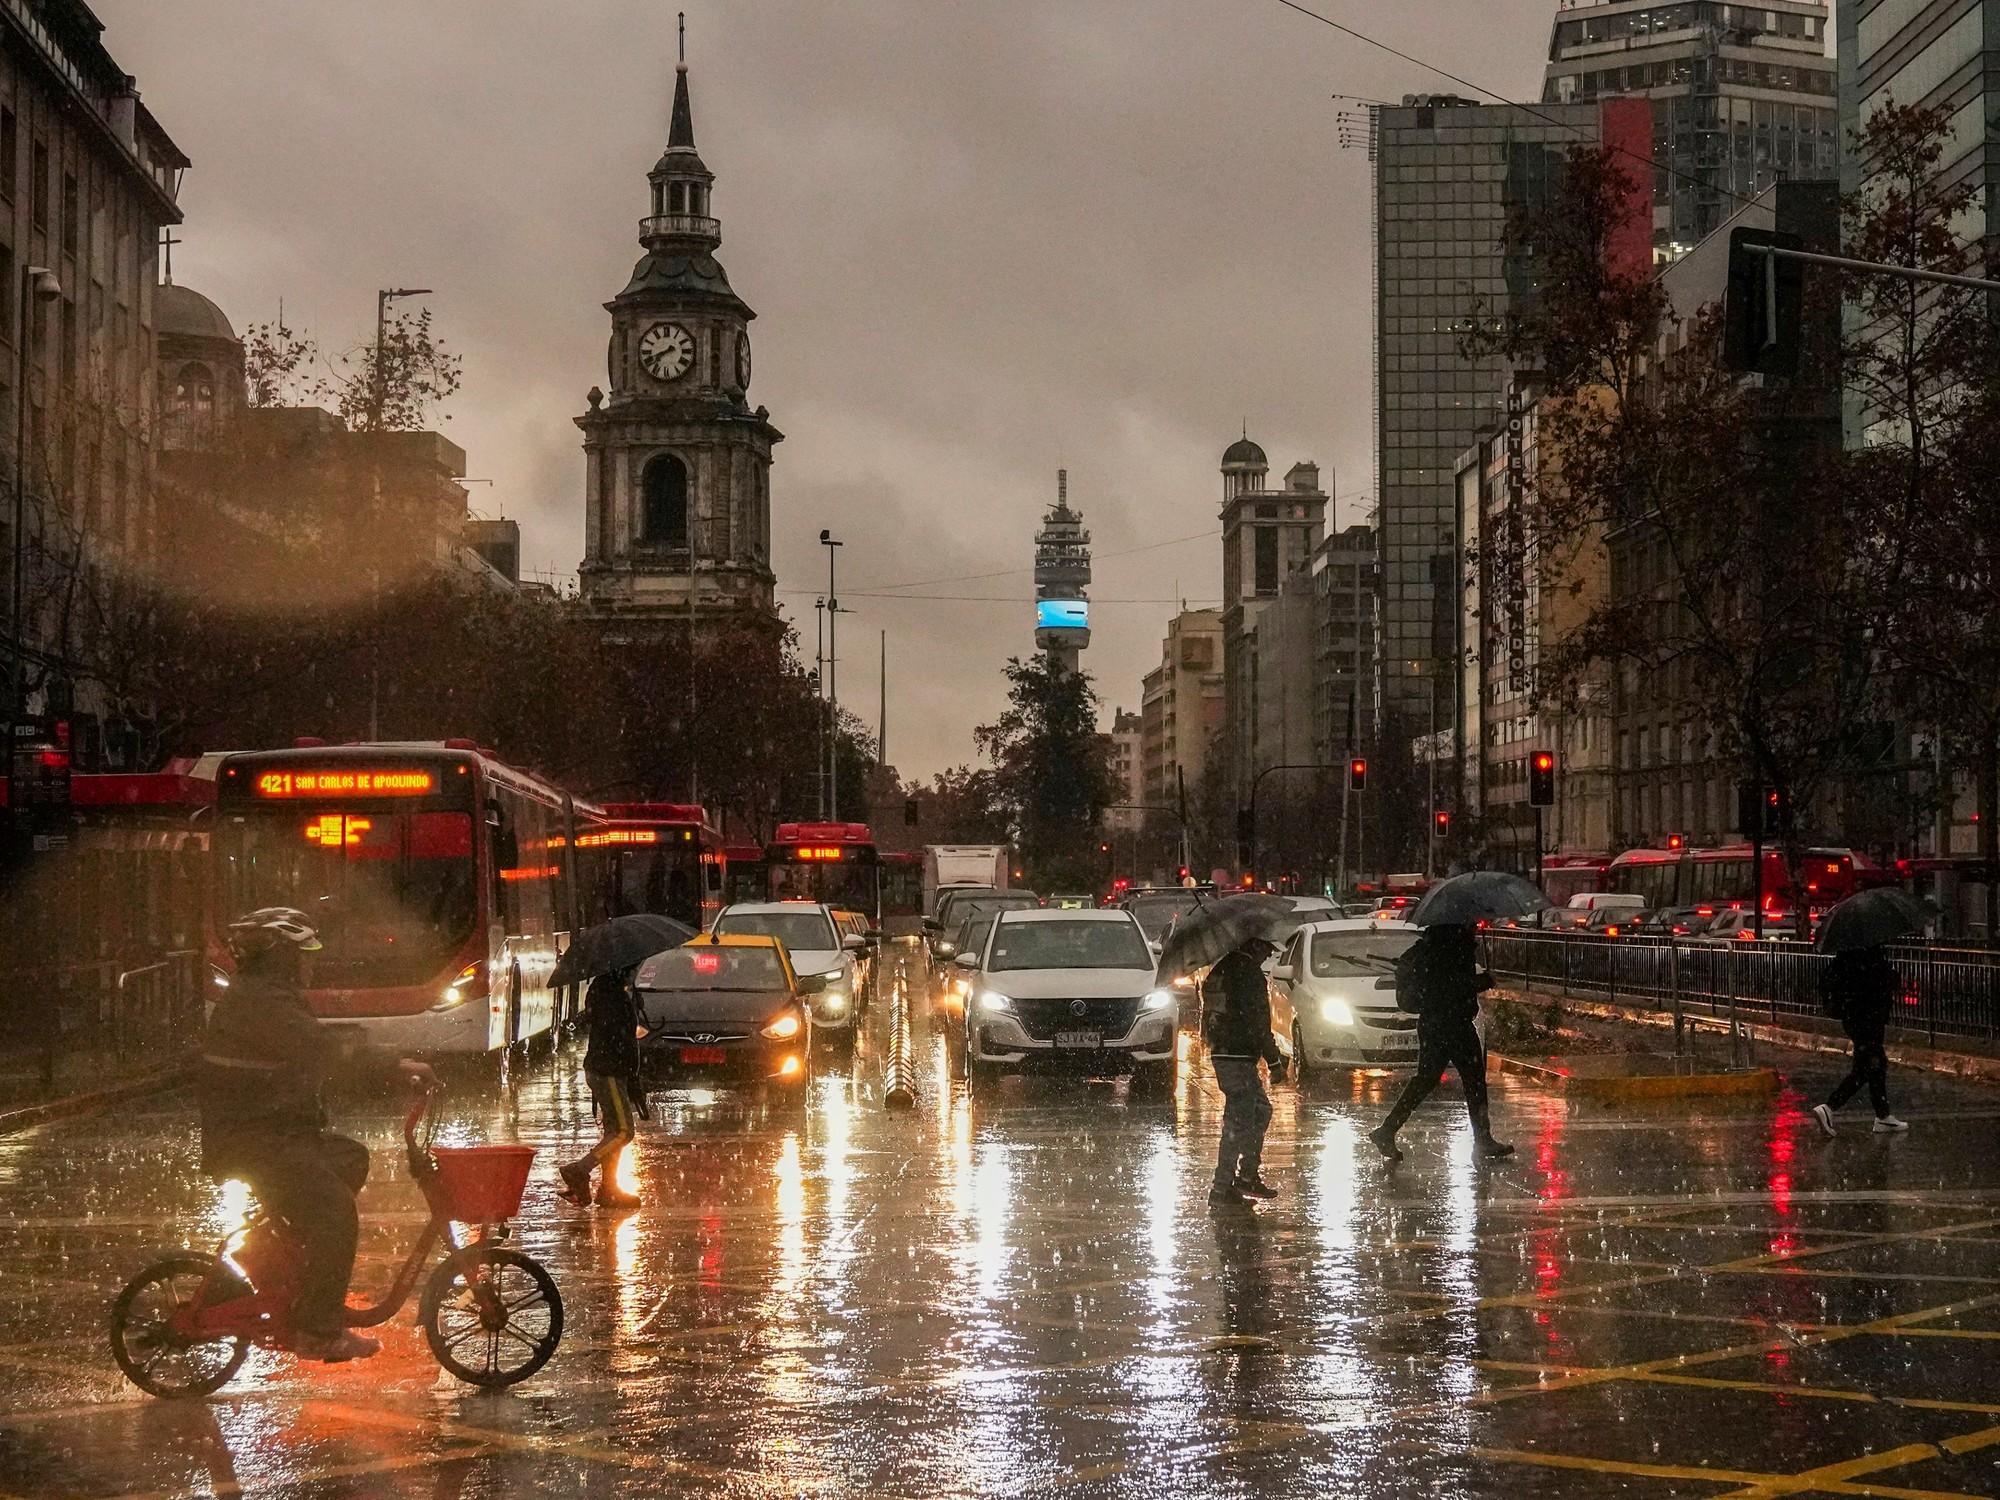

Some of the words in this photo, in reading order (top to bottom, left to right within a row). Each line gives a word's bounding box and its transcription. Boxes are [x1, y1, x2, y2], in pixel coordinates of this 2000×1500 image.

[1509, 399, 1521, 487] HOTEL
[1511, 503, 1524, 689] LBERTADOR
[260, 775, 291, 793] 421
[295, 775, 315, 788] SAN
[319, 775, 354, 788] CARLOS
[358, 775, 370, 788] DE
[374, 775, 429, 788] APOQUINDO
